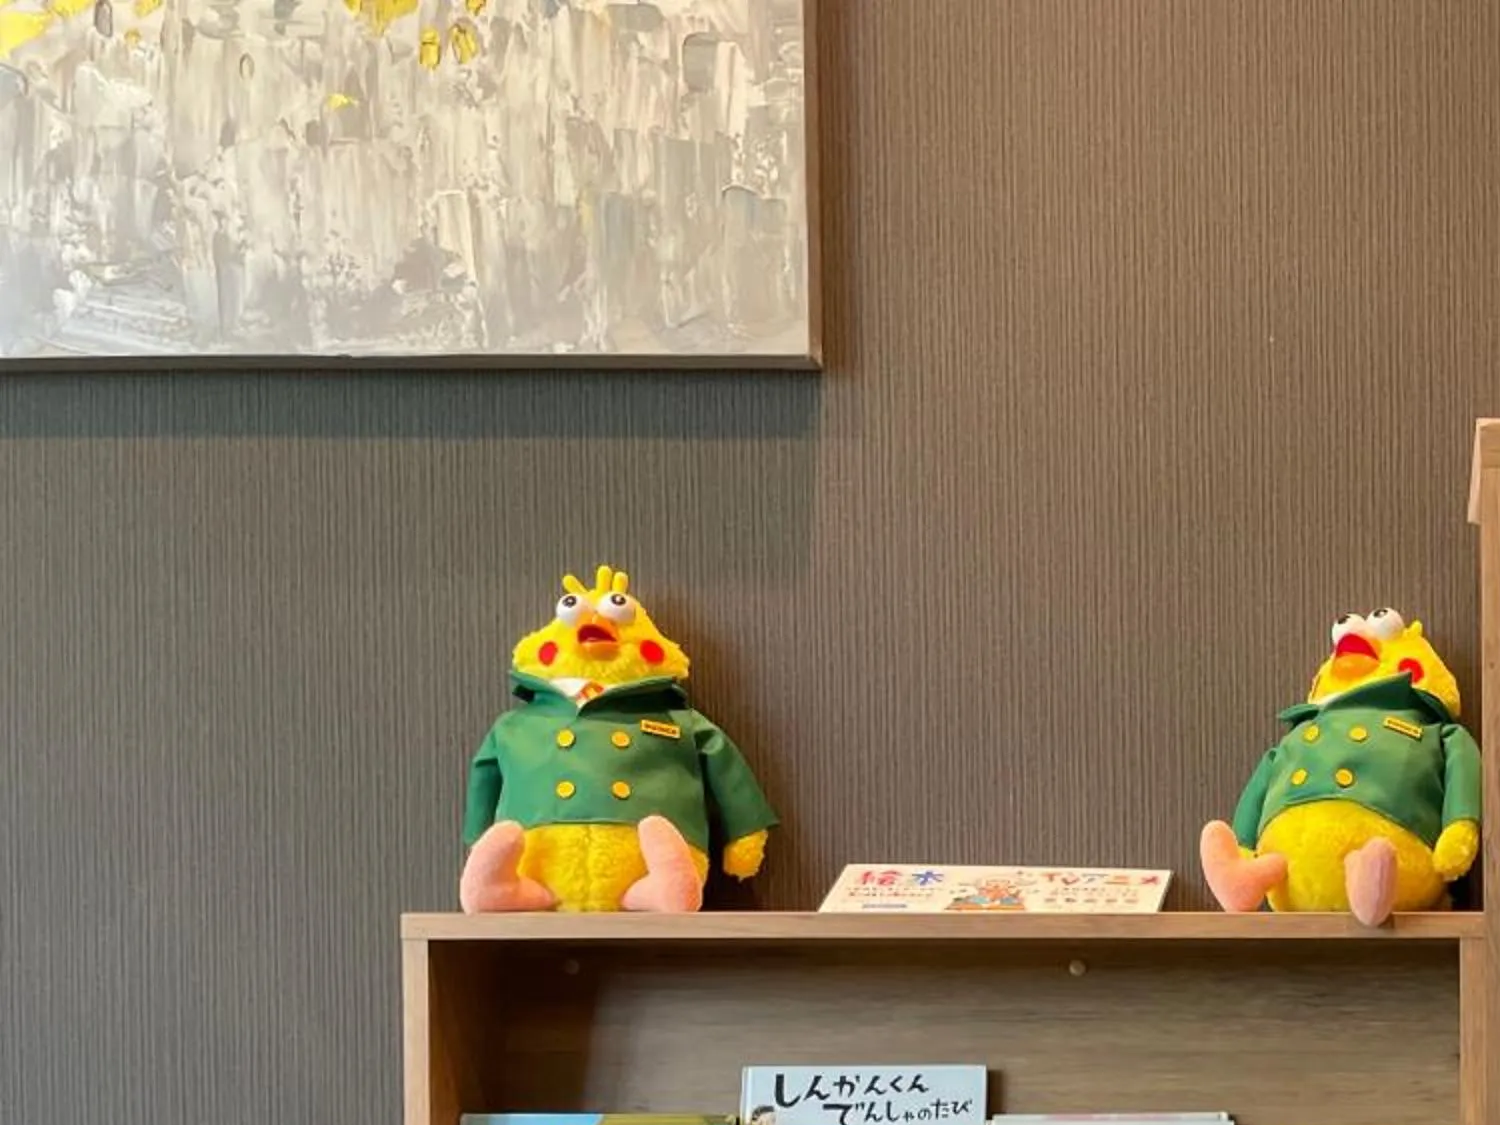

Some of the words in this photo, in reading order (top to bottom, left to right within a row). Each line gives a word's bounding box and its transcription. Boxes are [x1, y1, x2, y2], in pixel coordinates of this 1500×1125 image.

[774, 1073, 929, 1108] しんかんくん
